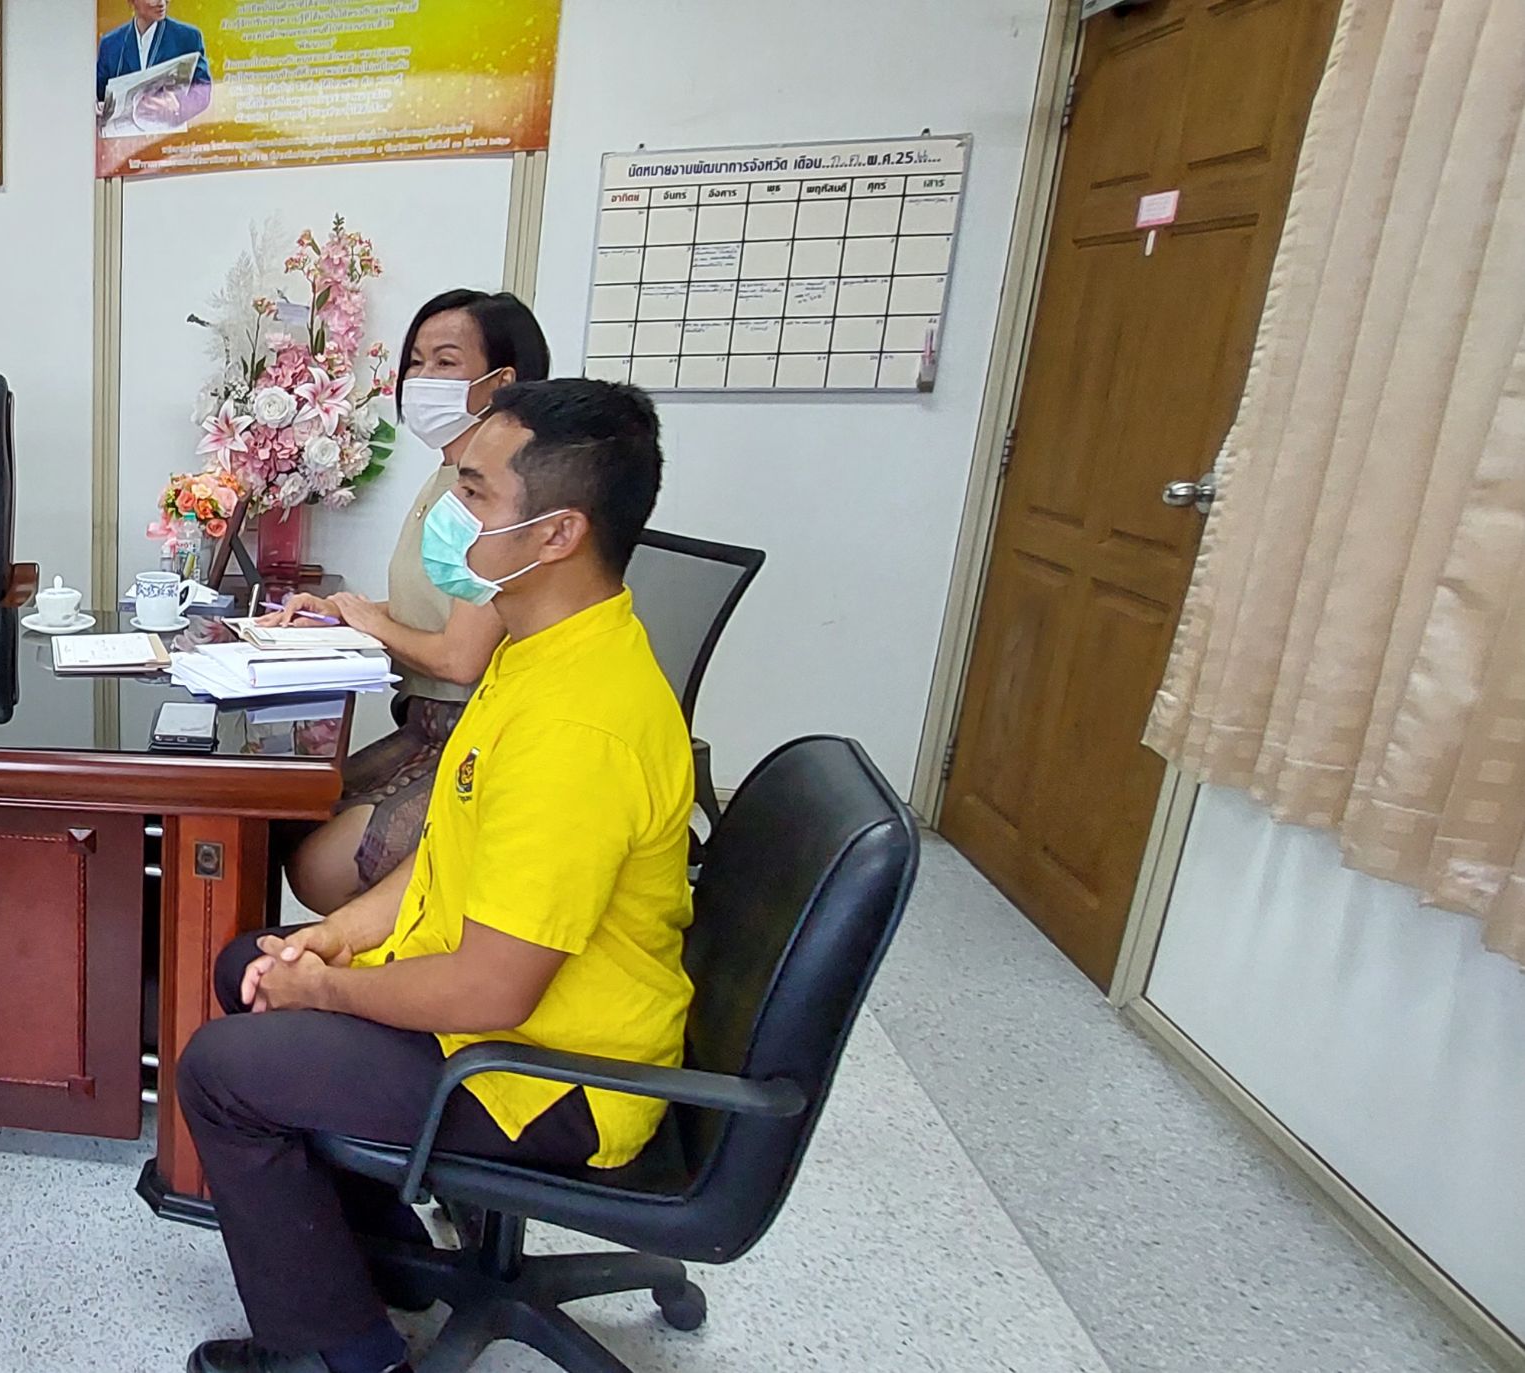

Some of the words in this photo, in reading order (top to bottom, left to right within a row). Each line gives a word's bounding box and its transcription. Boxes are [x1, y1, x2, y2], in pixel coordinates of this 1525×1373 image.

[628, 156, 788, 178] นัดหมายงานพัฒนาการจังหวัด
[793, 154, 823, 170] เดือน
[707, 187, 739, 199] อังคาร
[766, 184, 782, 196] พุธ
[805, 181, 848, 196] พฤหัสบดี
